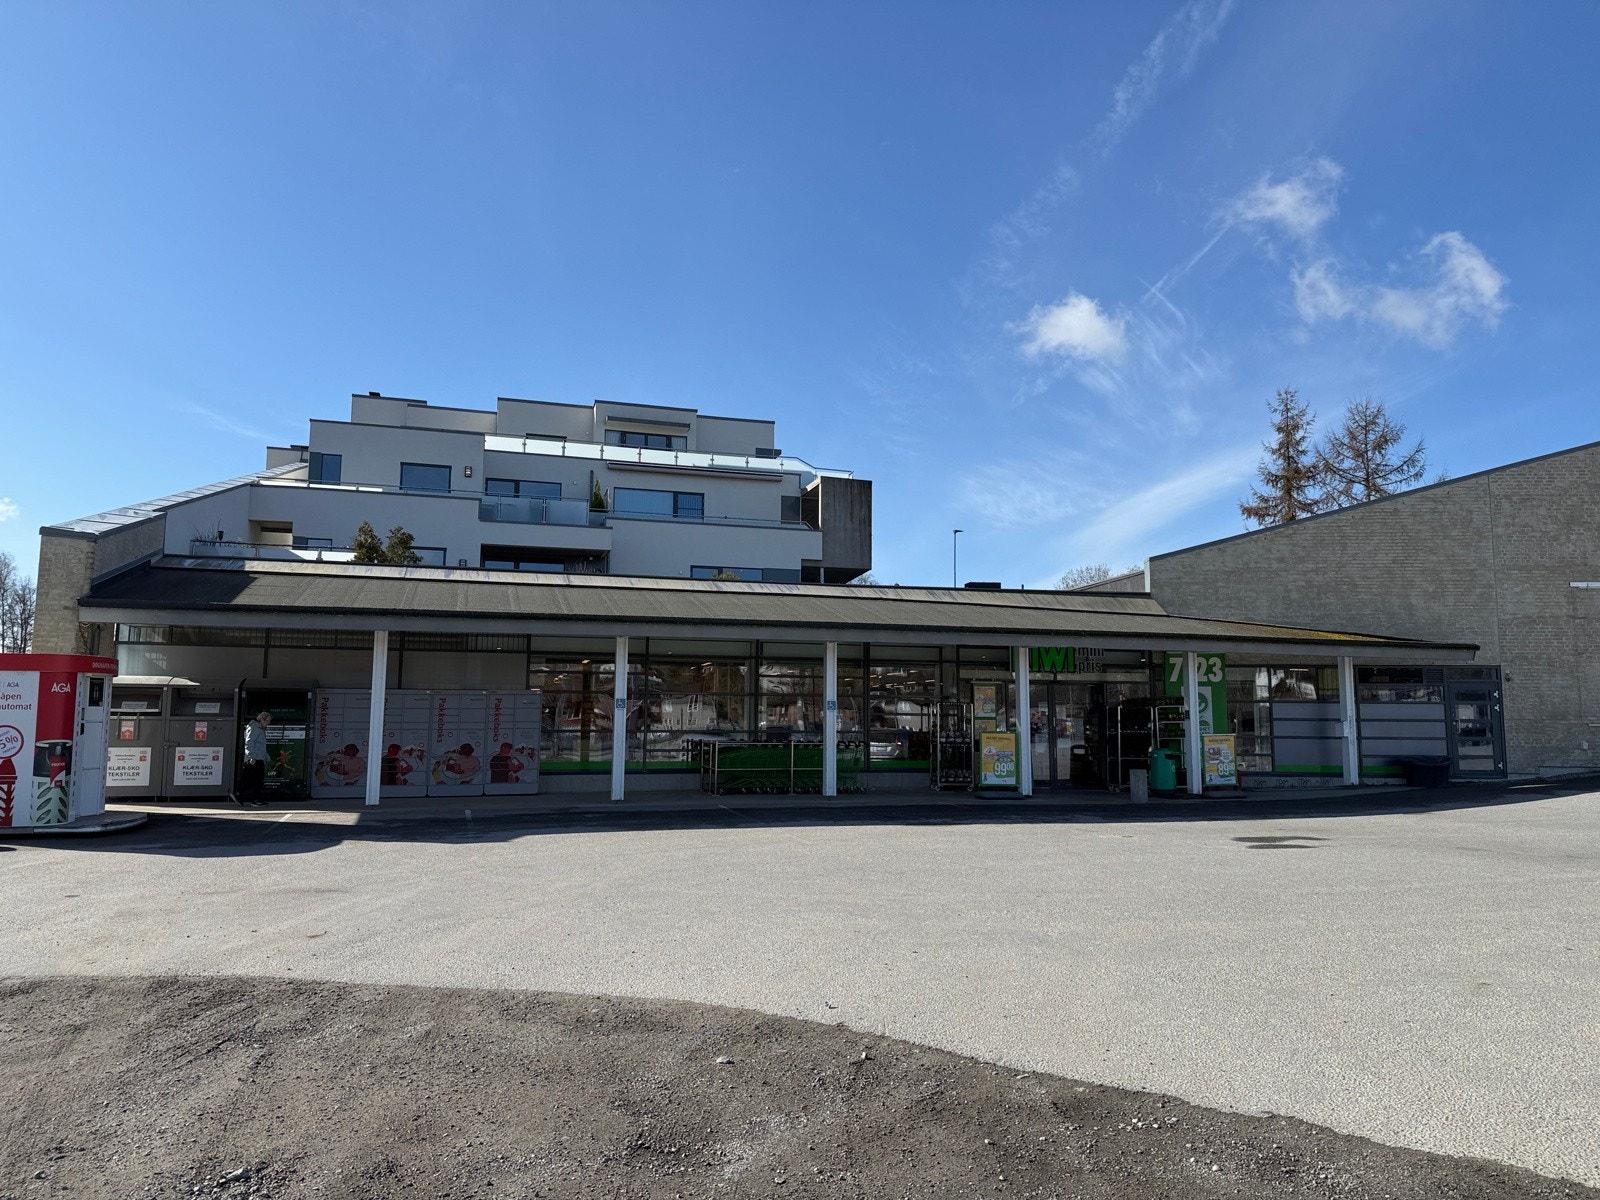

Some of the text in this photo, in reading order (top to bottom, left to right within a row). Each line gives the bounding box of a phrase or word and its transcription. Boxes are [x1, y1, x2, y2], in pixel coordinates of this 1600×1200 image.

[51, 682, 71, 693] AGA
[1078, 660, 1102, 674] pris
[319, 697, 329, 744] Pakkeboks
[436, 697, 446, 743] Pakkeboks
[492, 698, 502, 743] Pakkeboks
